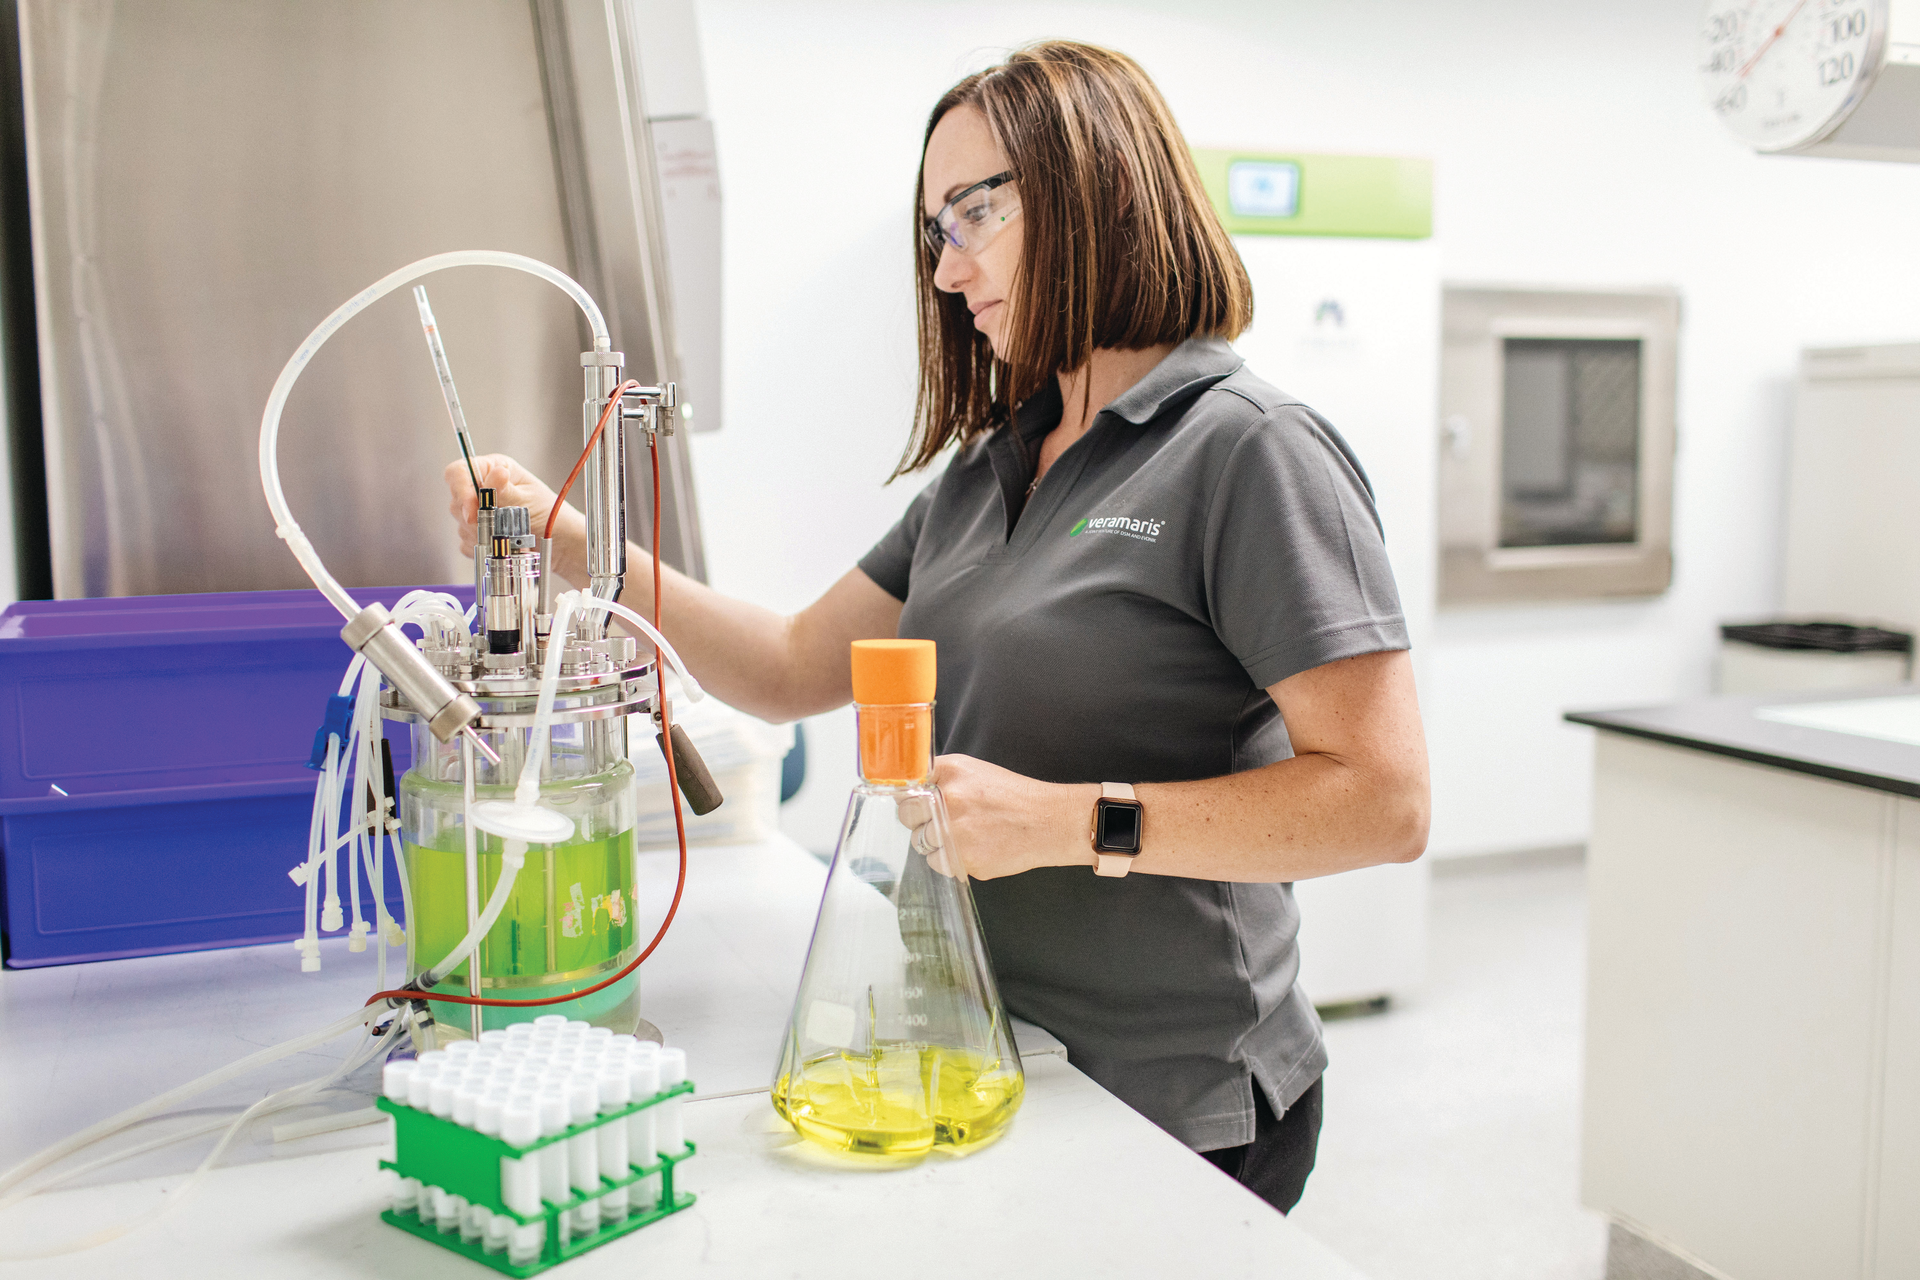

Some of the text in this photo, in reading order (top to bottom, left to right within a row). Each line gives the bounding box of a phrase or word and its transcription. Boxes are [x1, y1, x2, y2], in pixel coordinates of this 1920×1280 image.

[1831, 9, 1867, 43] 100
[1819, 51, 1854, 87] 120
[1088, 517, 1161, 536] veramaris
[1131, 532, 1141, 540] AND
